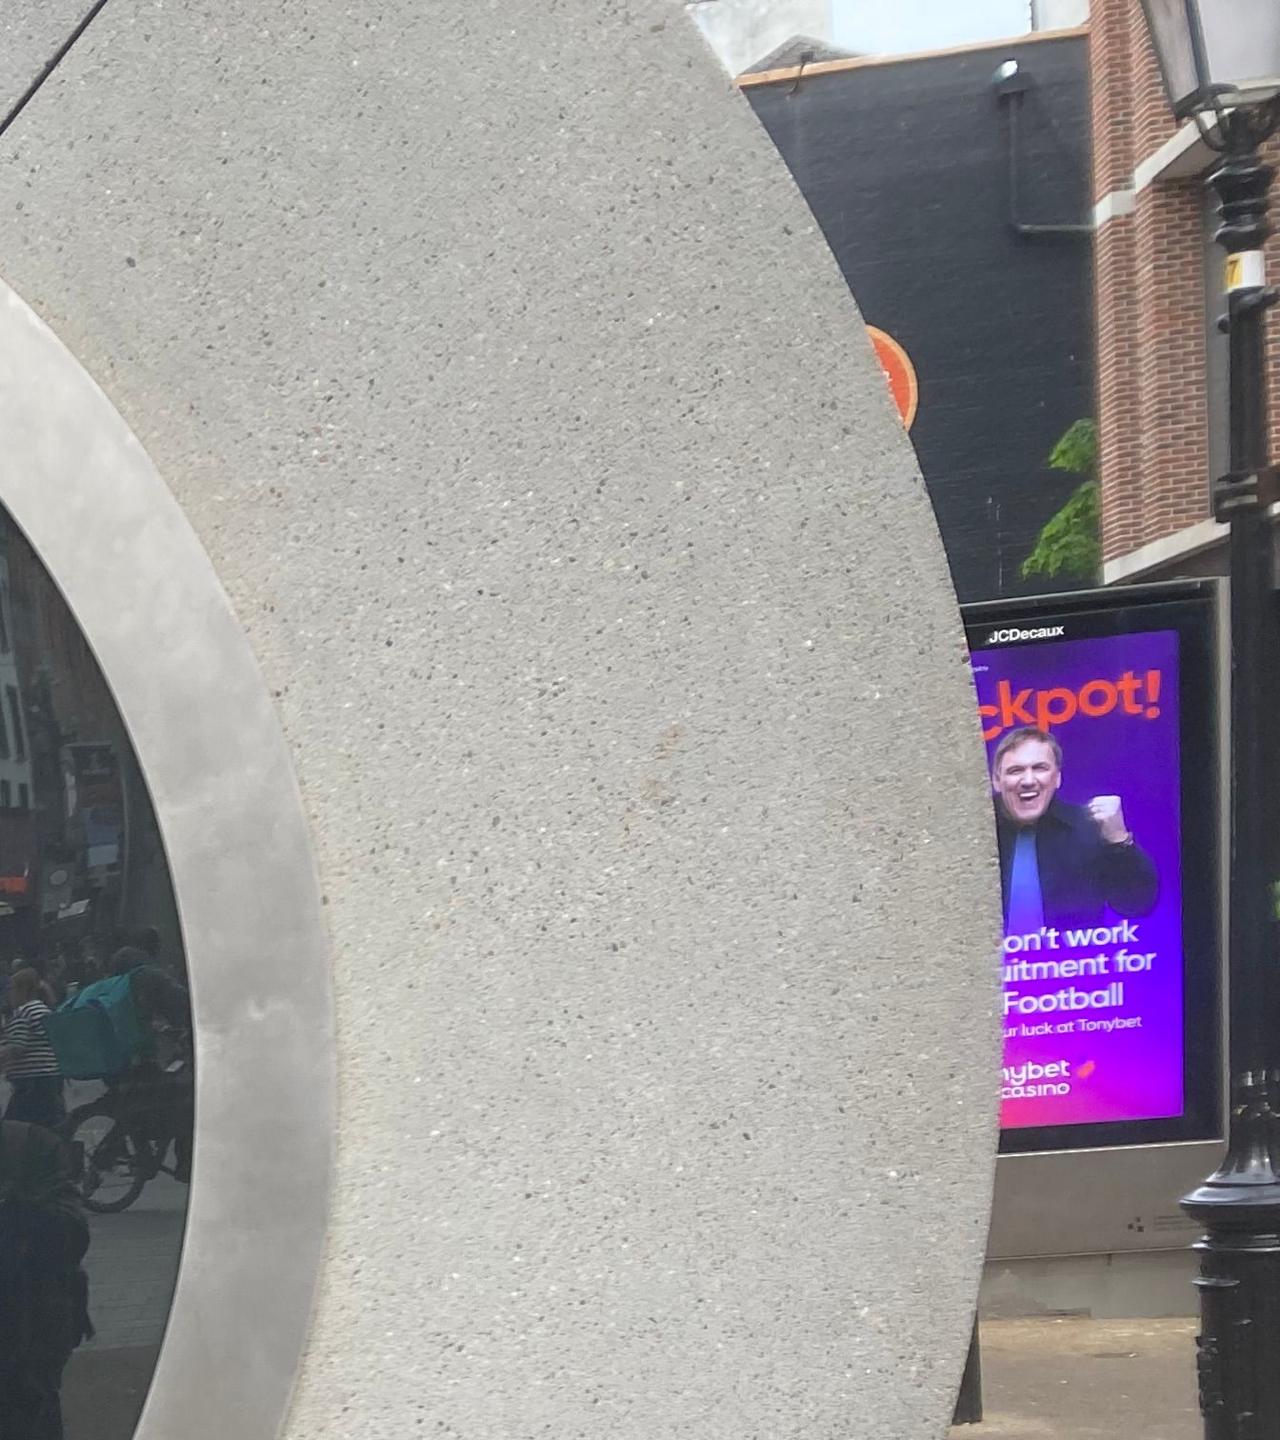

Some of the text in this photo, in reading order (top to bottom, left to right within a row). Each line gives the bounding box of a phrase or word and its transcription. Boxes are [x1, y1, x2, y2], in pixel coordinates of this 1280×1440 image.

[989, 625, 1065, 644] JCDecaux
[1066, 919, 1140, 948] work
[1115, 948, 1157, 973] for
[1003, 982, 1124, 1015] Football
[1021, 1022, 1054, 1037] luck
[1056, 1021, 1074, 1033] at
[1078, 1015, 1143, 1034] Tonybet
[1001, 1082, 1071, 1099] casino
